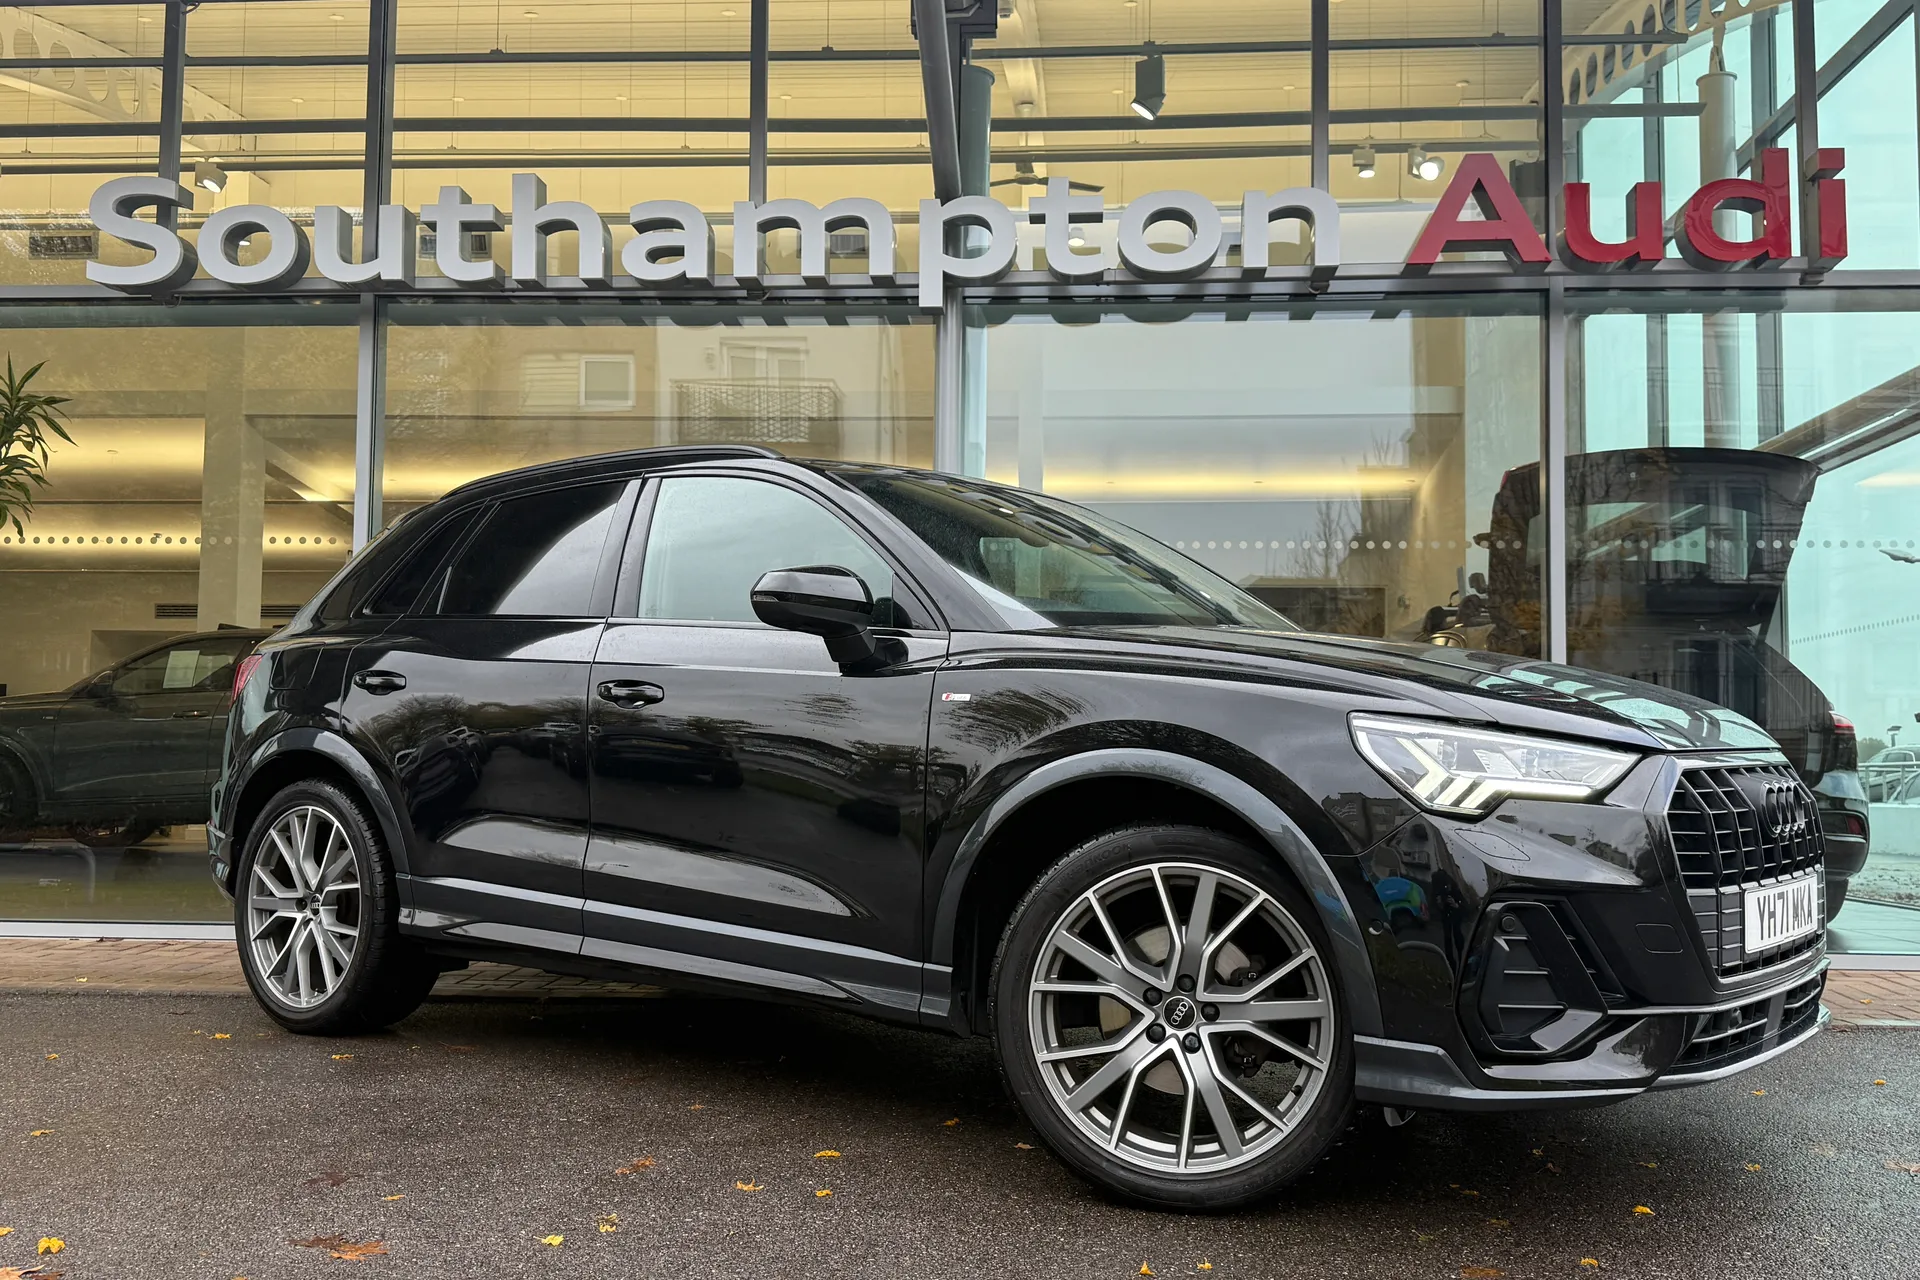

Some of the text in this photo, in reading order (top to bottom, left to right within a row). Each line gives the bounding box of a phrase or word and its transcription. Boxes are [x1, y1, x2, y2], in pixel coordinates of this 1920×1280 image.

[85, 147, 1849, 308] Southampton Audi
[1757, 883, 1813, 941] YH71 MKA
